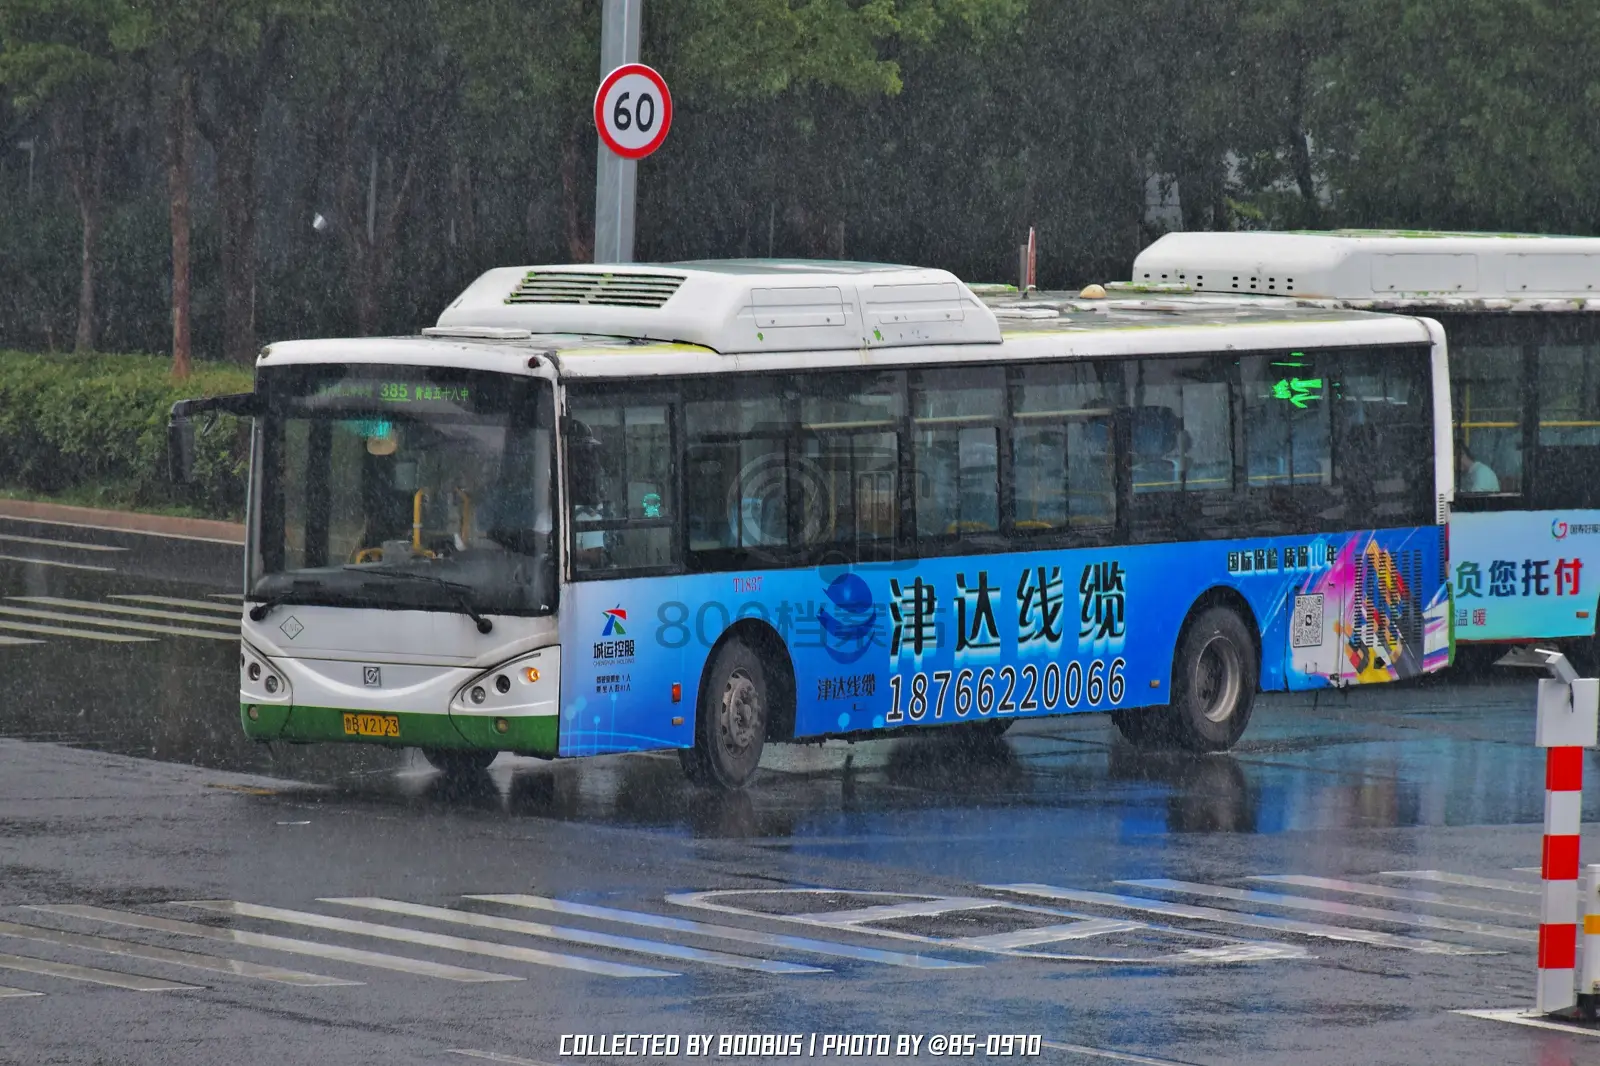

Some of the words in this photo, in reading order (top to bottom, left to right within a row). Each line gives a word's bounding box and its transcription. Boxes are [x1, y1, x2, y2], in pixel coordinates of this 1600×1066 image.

[613, 91, 655, 133] 60
[380, 382, 408, 398] 385
[1456, 557, 1583, 599] 负您托付
[889, 560, 1127, 657] 津达线缆
[1455, 607, 1487, 627] 温暖
[593, 640, 635, 659] 城运控股
[817, 672, 876, 701] 津达线缆
[886, 657, 1127, 723] 18766220066
